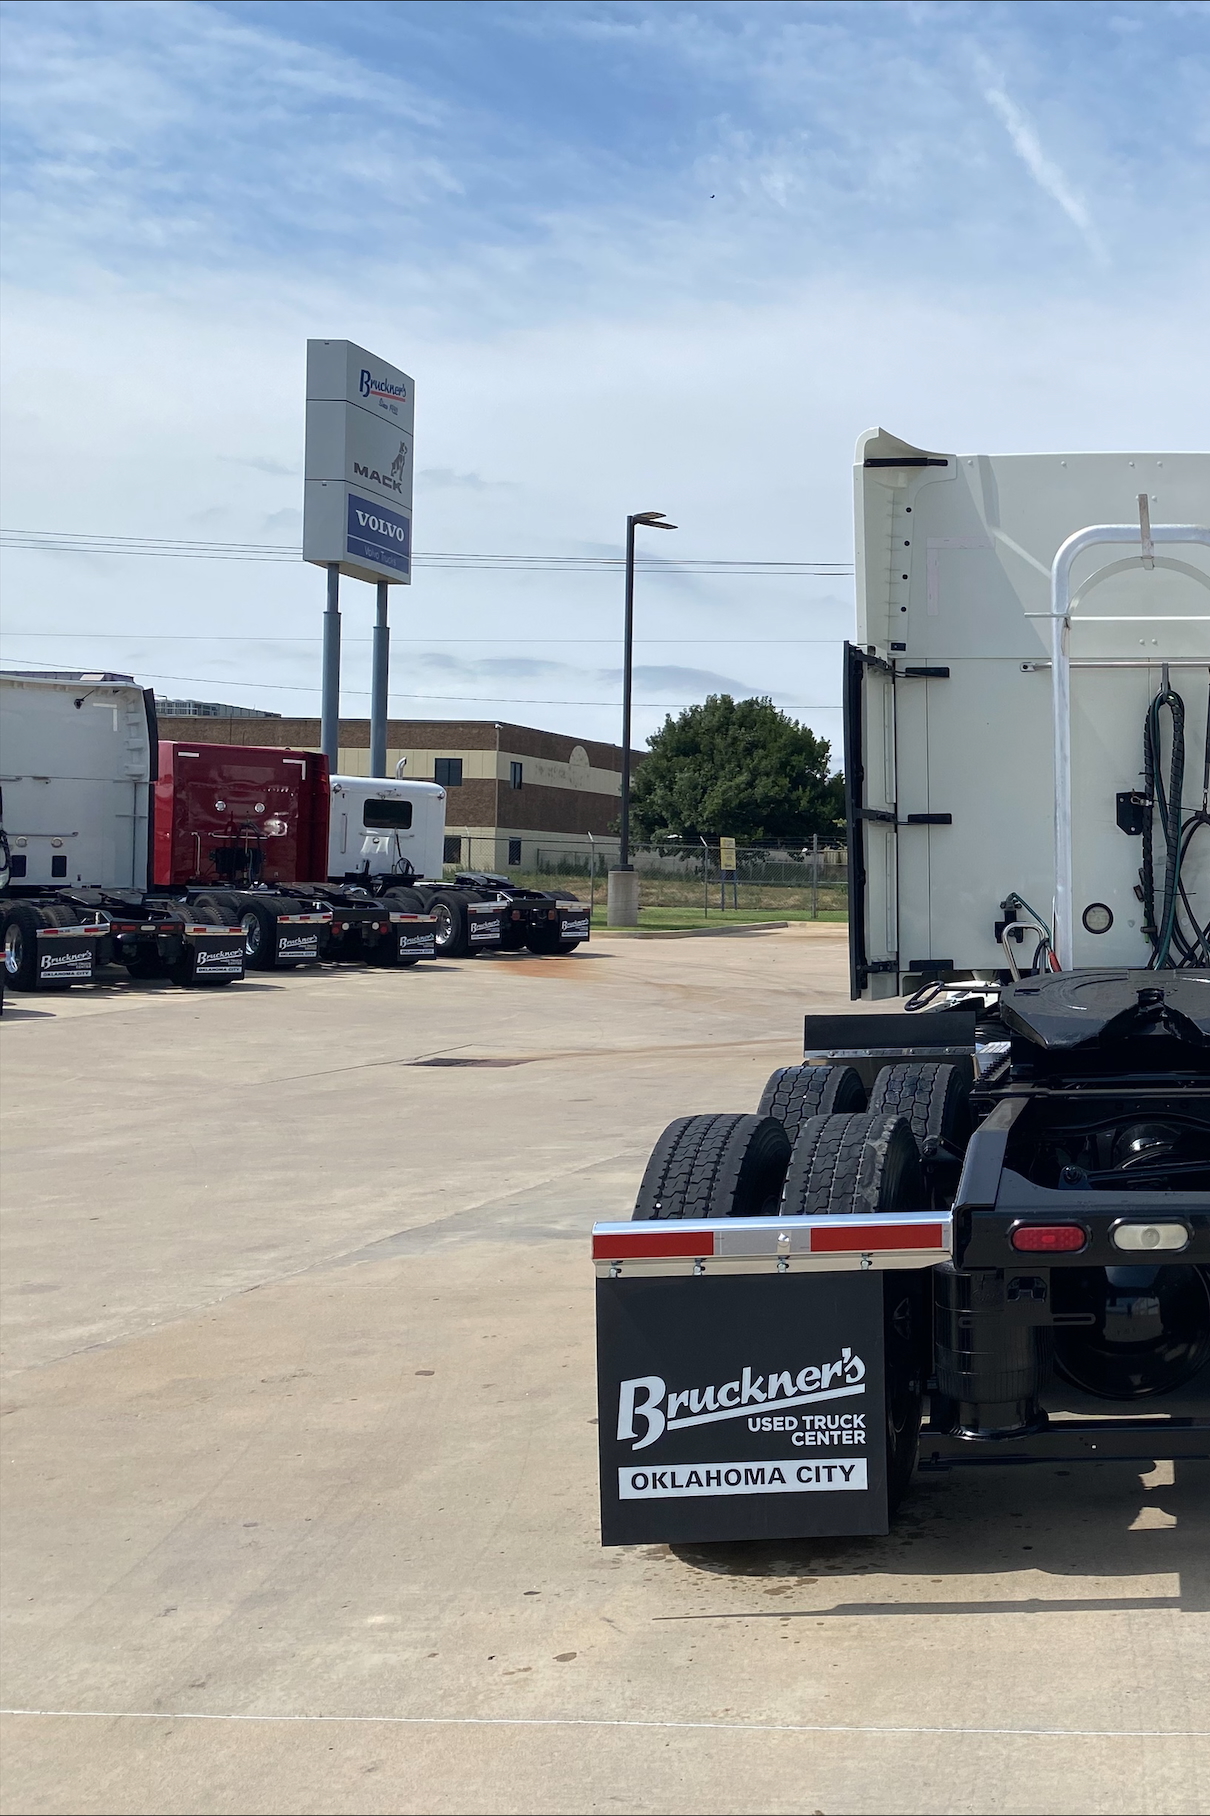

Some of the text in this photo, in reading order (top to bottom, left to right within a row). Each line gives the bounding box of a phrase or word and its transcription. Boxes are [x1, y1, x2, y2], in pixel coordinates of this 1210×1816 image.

[359, 368, 407, 398] Bruckner's
[353, 461, 403, 495] MACK
[355, 509, 405, 543] VOLVO
[364, 545, 397, 567] Volvo Trucks
[279, 935, 317, 950] Bruckner's
[41, 950, 92, 969] Bruckner's
[197, 949, 244, 965] Bruckner's
[617, 1347, 866, 1451] Bruckner's
[747, 1413, 866, 1432] USED TRUCK
[791, 1431, 867, 1446] CENTER
[630, 1464, 856, 1491] OKLAHOMA CITY
